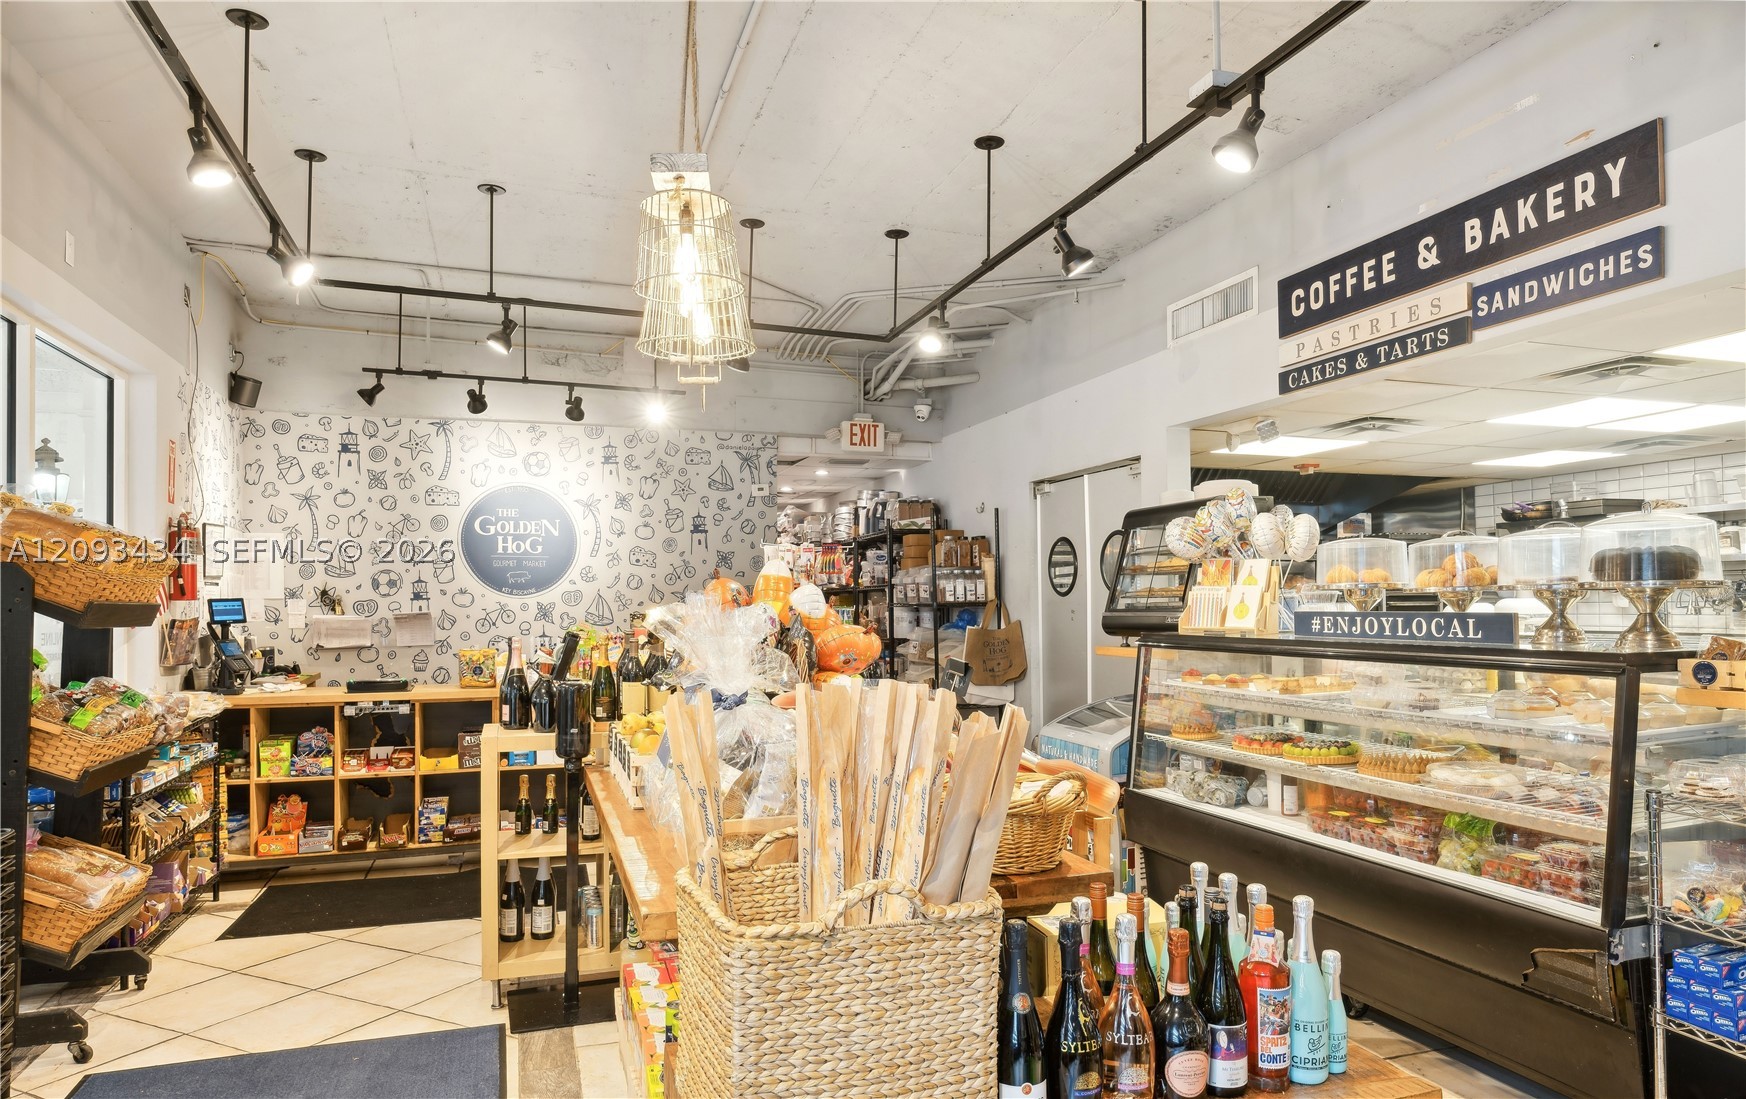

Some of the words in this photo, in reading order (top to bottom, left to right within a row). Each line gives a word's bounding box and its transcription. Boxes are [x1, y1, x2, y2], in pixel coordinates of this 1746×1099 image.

[1291, 251, 1396, 317] COFFEE
[1417, 236, 1441, 270] &
[1464, 156, 1627, 254] BAKERY
[1476, 243, 1654, 317] SANDWICHES
[1296, 297, 1443, 358] PASTRIES
[1288, 357, 1347, 389] CAKES
[1355, 352, 1368, 370] &
[1377, 327, 1450, 364] TARTS
[849, 423, 879, 448] EXIT
[474, 515, 561, 537] GOLDEN
[496, 508, 519, 517] THE
[492, 560, 517, 568] GOURMET
[522, 560, 547, 568] MARKET
[512, 588, 537, 596] BISCAYNE
[1311, 616, 1483, 639] #ENJOYLOCAL
[697, 785, 715, 838] Baguette
[801, 777, 810, 829] Baguette
[831, 776, 842, 829] Baguette
[869, 773, 879, 825] Baguette
[918, 785, 928, 836] Baguette
[710, 857, 721, 892] Crispy
[802, 847, 810, 885] Crispy
[910, 853, 919, 888] Crust
[1260, 1035, 1288, 1048] SPRITZ
[1260, 1046, 1273, 1054] DEL
[1260, 1053, 1287, 1064] CONTE
